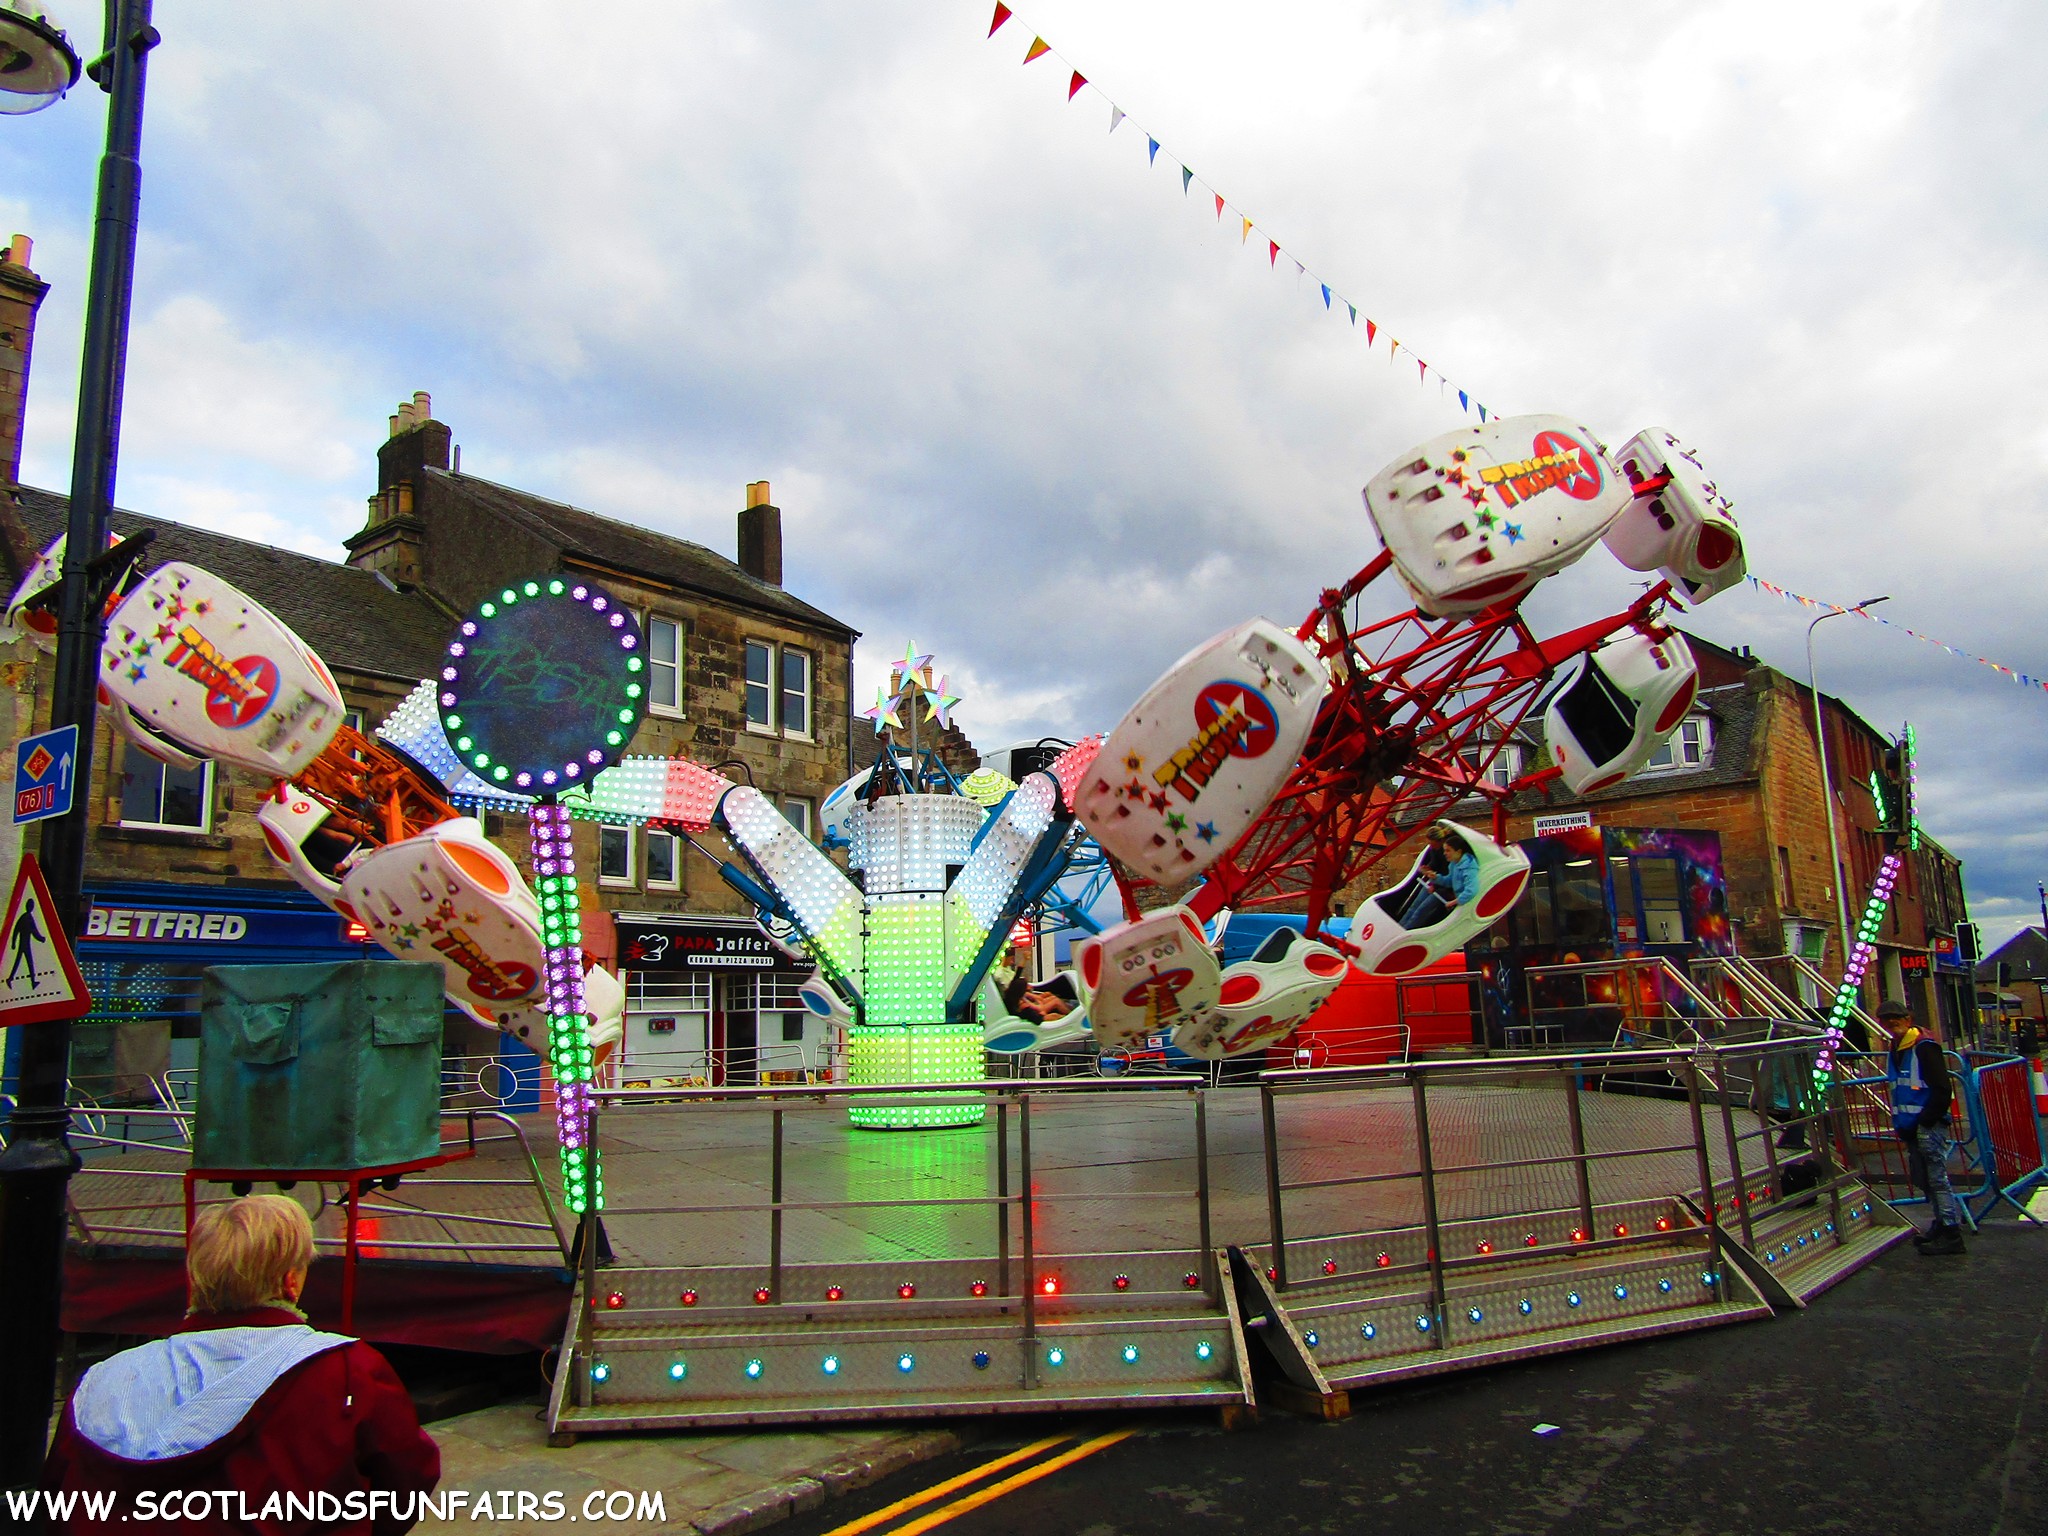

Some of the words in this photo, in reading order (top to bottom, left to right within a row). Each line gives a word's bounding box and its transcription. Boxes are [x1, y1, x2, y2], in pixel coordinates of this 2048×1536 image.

[19, 790, 42, 812] (76)
[48, 788, 52, 803] 1
[1537, 815, 1587, 828] INVERKEITHING
[86, 909, 247, 941] BETFRED
[674, 936, 715, 950] PAPA
[716, 937, 770, 952] Jaffer
[689, 956, 714, 964] KEBAB
[1901, 955, 1928, 969] CAFE
